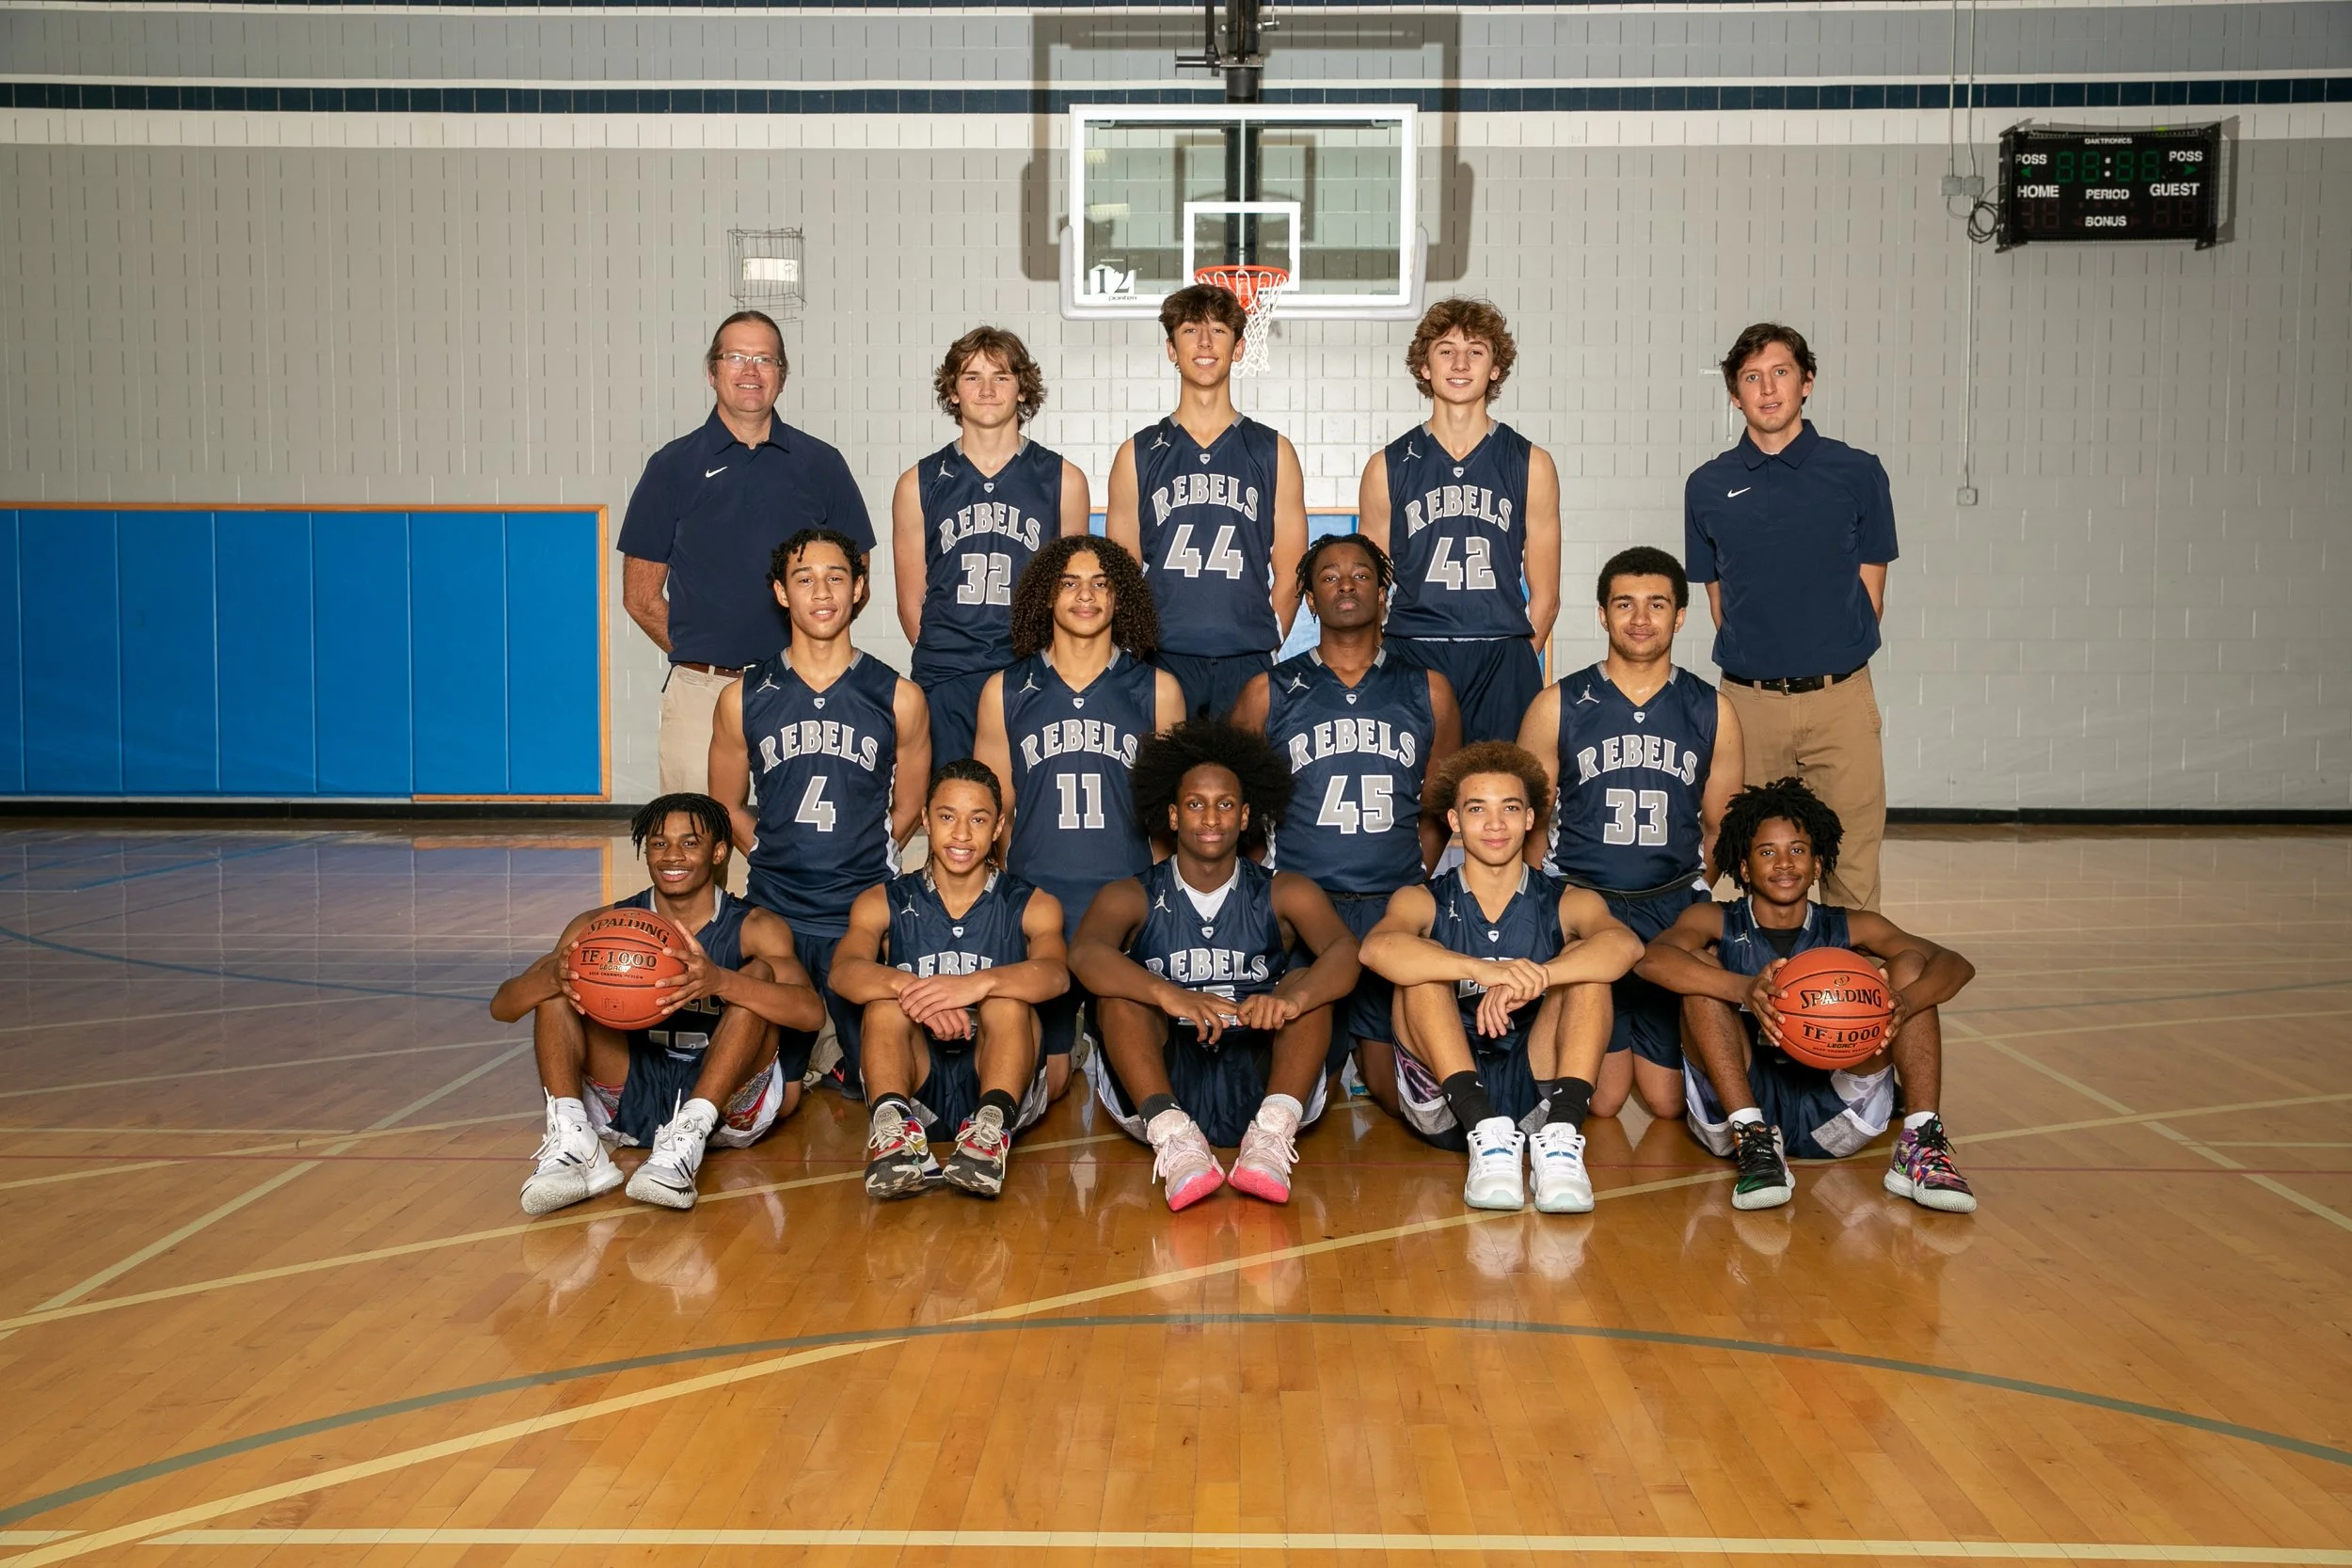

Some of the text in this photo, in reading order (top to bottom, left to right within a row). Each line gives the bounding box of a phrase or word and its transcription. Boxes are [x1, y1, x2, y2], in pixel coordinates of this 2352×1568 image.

[2015, 153, 2047, 165] POSS
[2169, 150, 2203, 162] POSS
[2017, 185, 2059, 198] HOME
[2085, 189, 2130, 199] PERIOD
[2150, 183, 2201, 197] GUEST
[2085, 216, 2127, 227] BONUS
[1152, 473, 1259, 526] REBELS
[1405, 484, 1513, 539] REBELS
[939, 502, 1041, 554] REBELS
[1163, 524, 1243, 579] 44
[957, 552, 1011, 606] 32
[1424, 536, 1496, 590] 42
[759, 720, 878, 774] REBELS
[1020, 719, 1138, 774] REBELS
[1288, 718, 1416, 774] REBELS
[1577, 735, 1697, 785] REBELS
[794, 776, 836, 832] 4
[1057, 773, 1104, 829] 11
[1316, 775, 1394, 834] 45
[1603, 788, 1668, 846] 33
[588, 918, 670, 945] SPALDING
[599, 964, 629, 973] LEGAC
[1145, 948, 1269, 982] REBELS
[1800, 989, 1882, 1009] SPALDING
